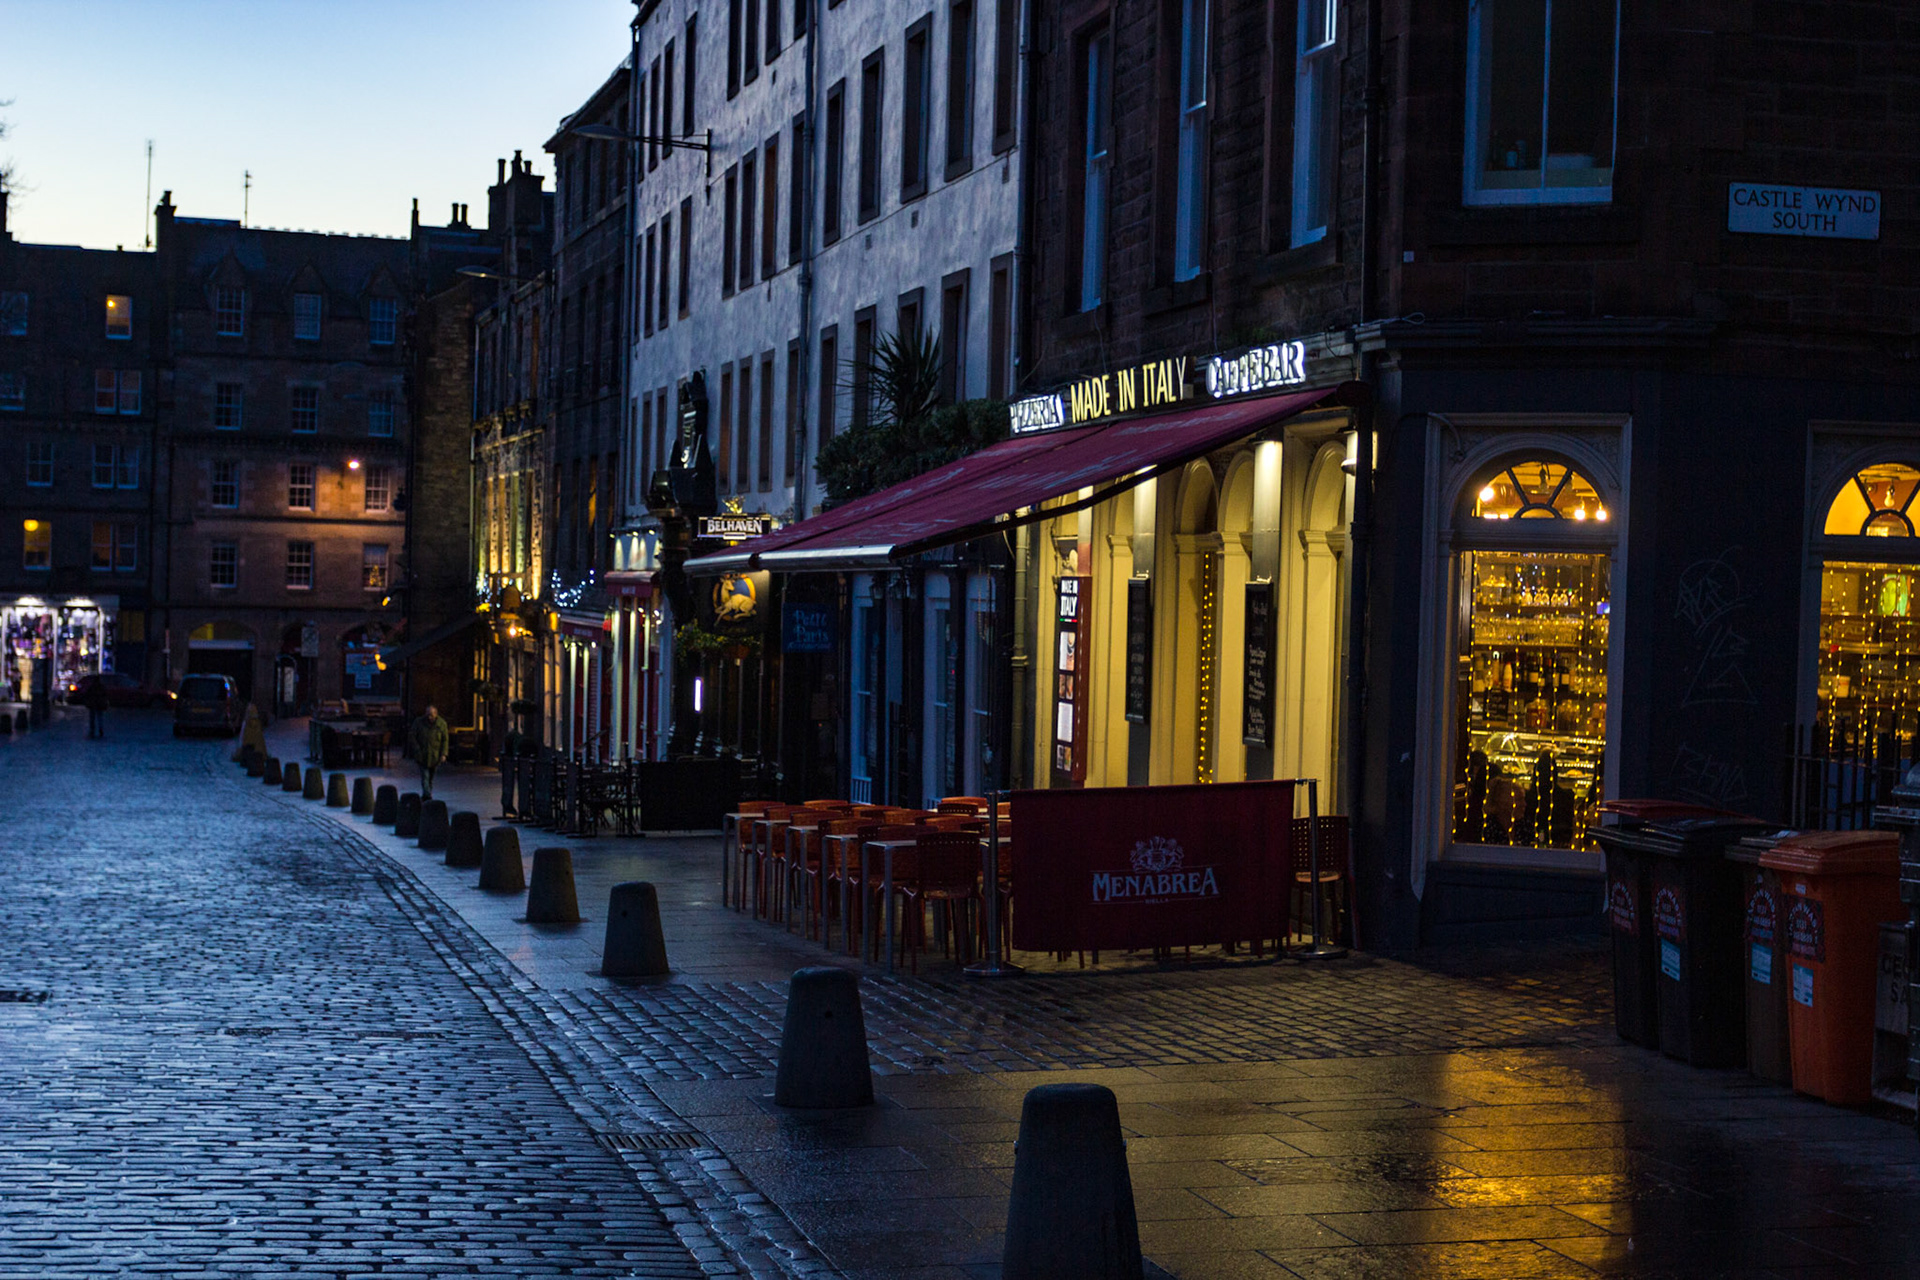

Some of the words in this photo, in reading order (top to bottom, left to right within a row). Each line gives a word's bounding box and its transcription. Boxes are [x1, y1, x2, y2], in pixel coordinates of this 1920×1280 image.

[1733, 188, 1802, 210] CASTLE
[1815, 193, 1877, 214] WYND
[1772, 212, 1837, 232] SOUTH
[1071, 374, 1112, 424] MADE
[1118, 367, 1136, 412] IN
[1143, 355, 1188, 408] ITALY
[706, 519, 763, 534] BELHAVEN
[1061, 579, 1072, 593] MADE
[1060, 595, 1078, 616] ITALY
[1092, 867, 1220, 902] MENABREA
